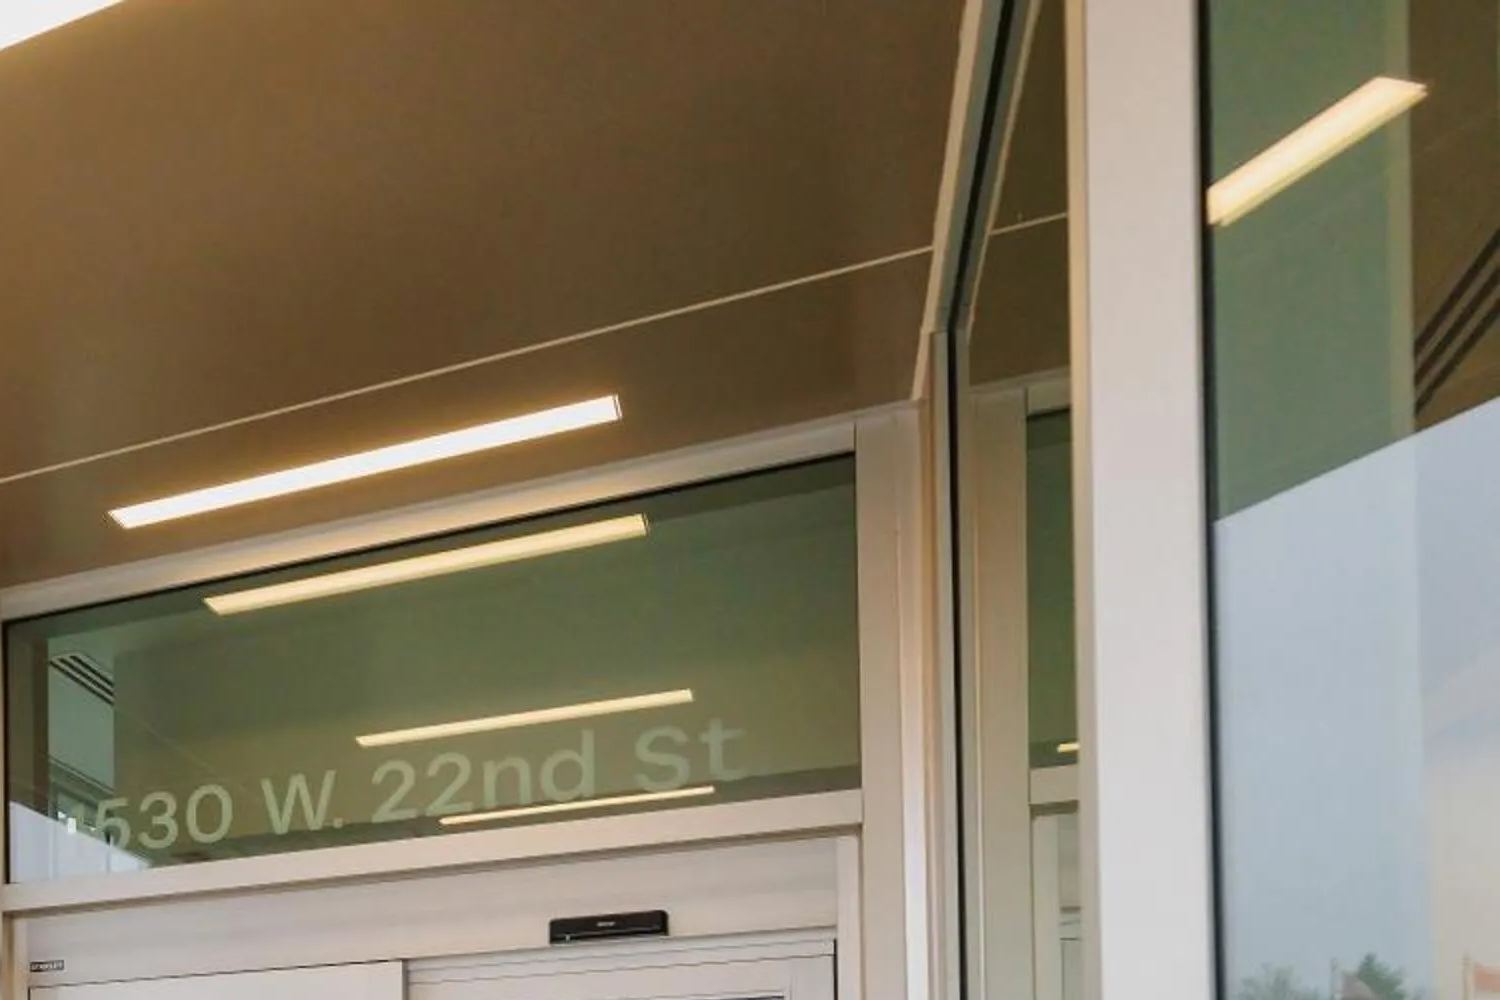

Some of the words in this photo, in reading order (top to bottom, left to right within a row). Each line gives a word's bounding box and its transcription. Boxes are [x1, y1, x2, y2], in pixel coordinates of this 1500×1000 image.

[261, 769, 343, 835] W.
[371, 729, 597, 824] 22nd
[634, 717, 749, 793] St
